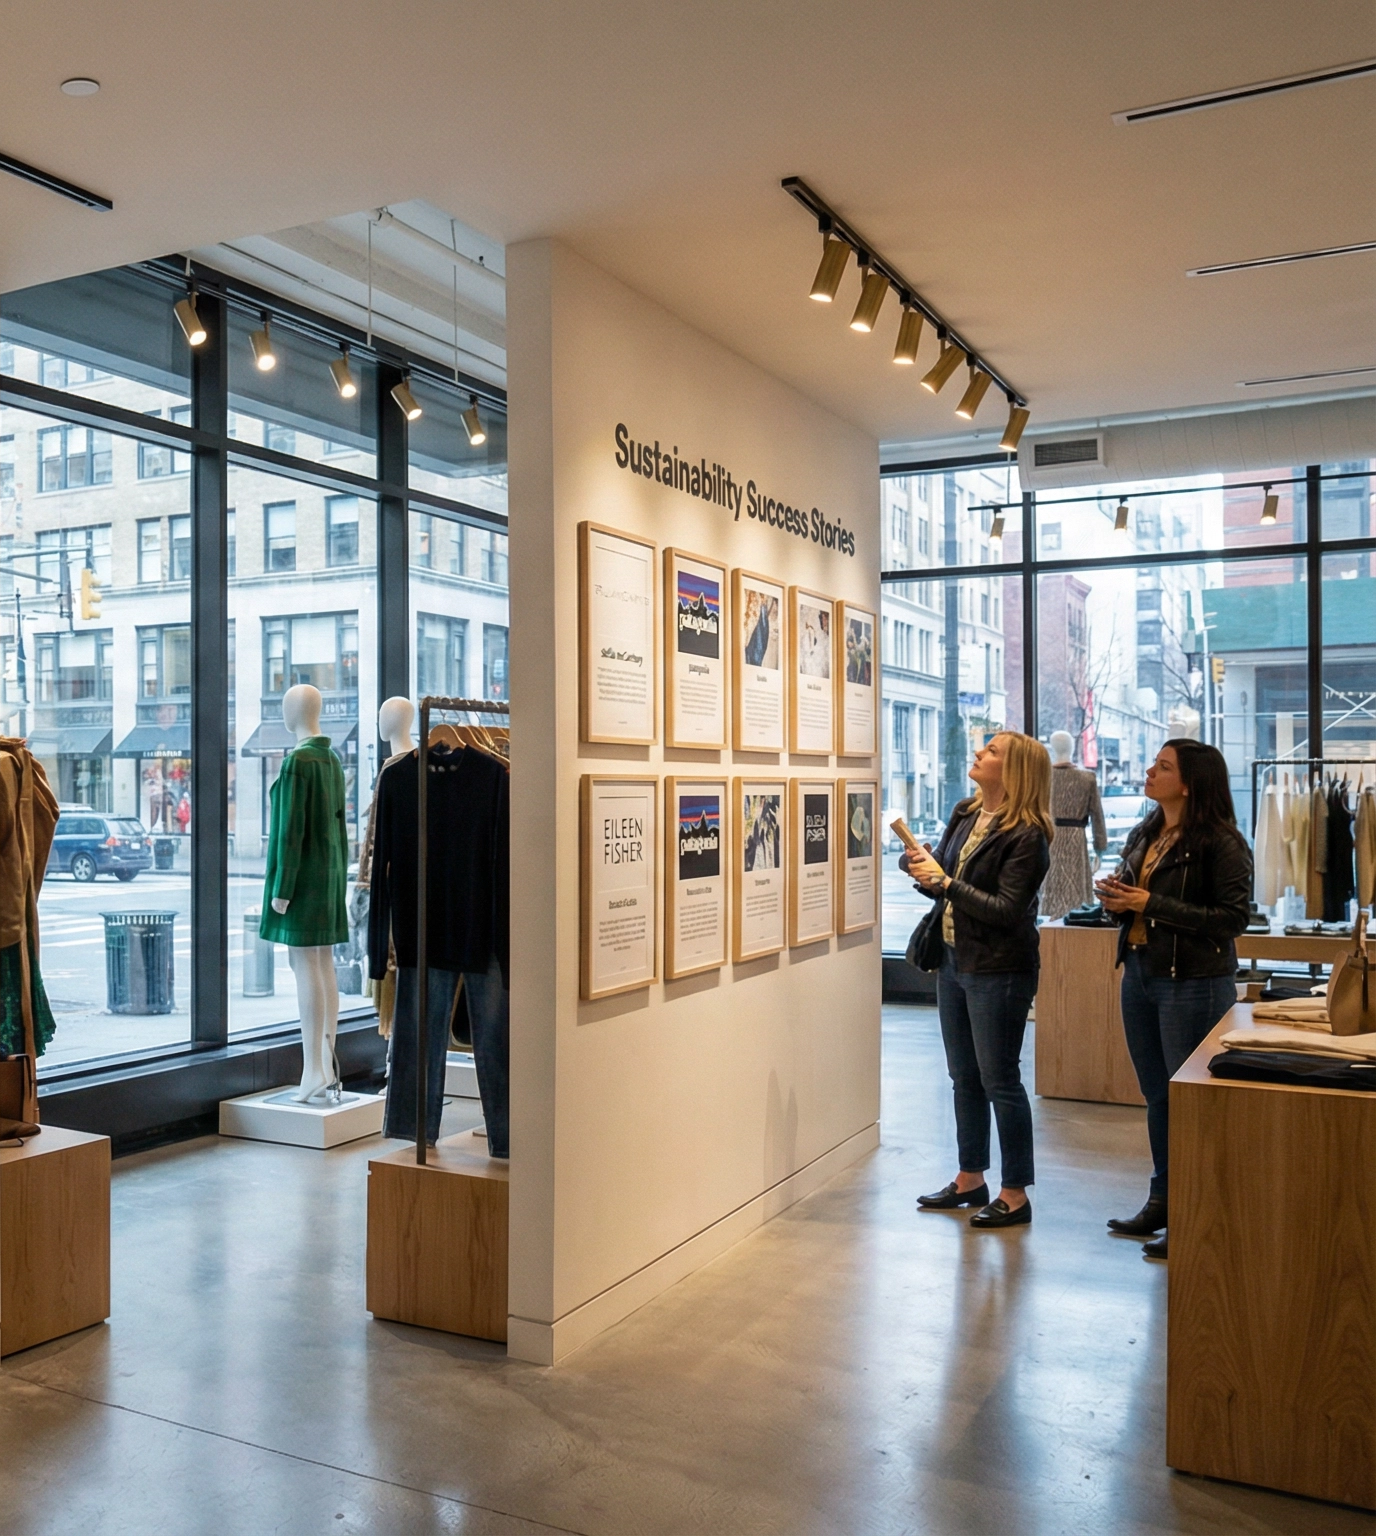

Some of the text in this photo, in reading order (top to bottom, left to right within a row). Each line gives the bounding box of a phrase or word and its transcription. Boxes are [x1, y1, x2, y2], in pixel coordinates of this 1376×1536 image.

[615, 423, 855, 557] Sustainability Success Stories
[604, 818, 643, 840] EILEEN
[604, 841, 643, 864] FISHER
